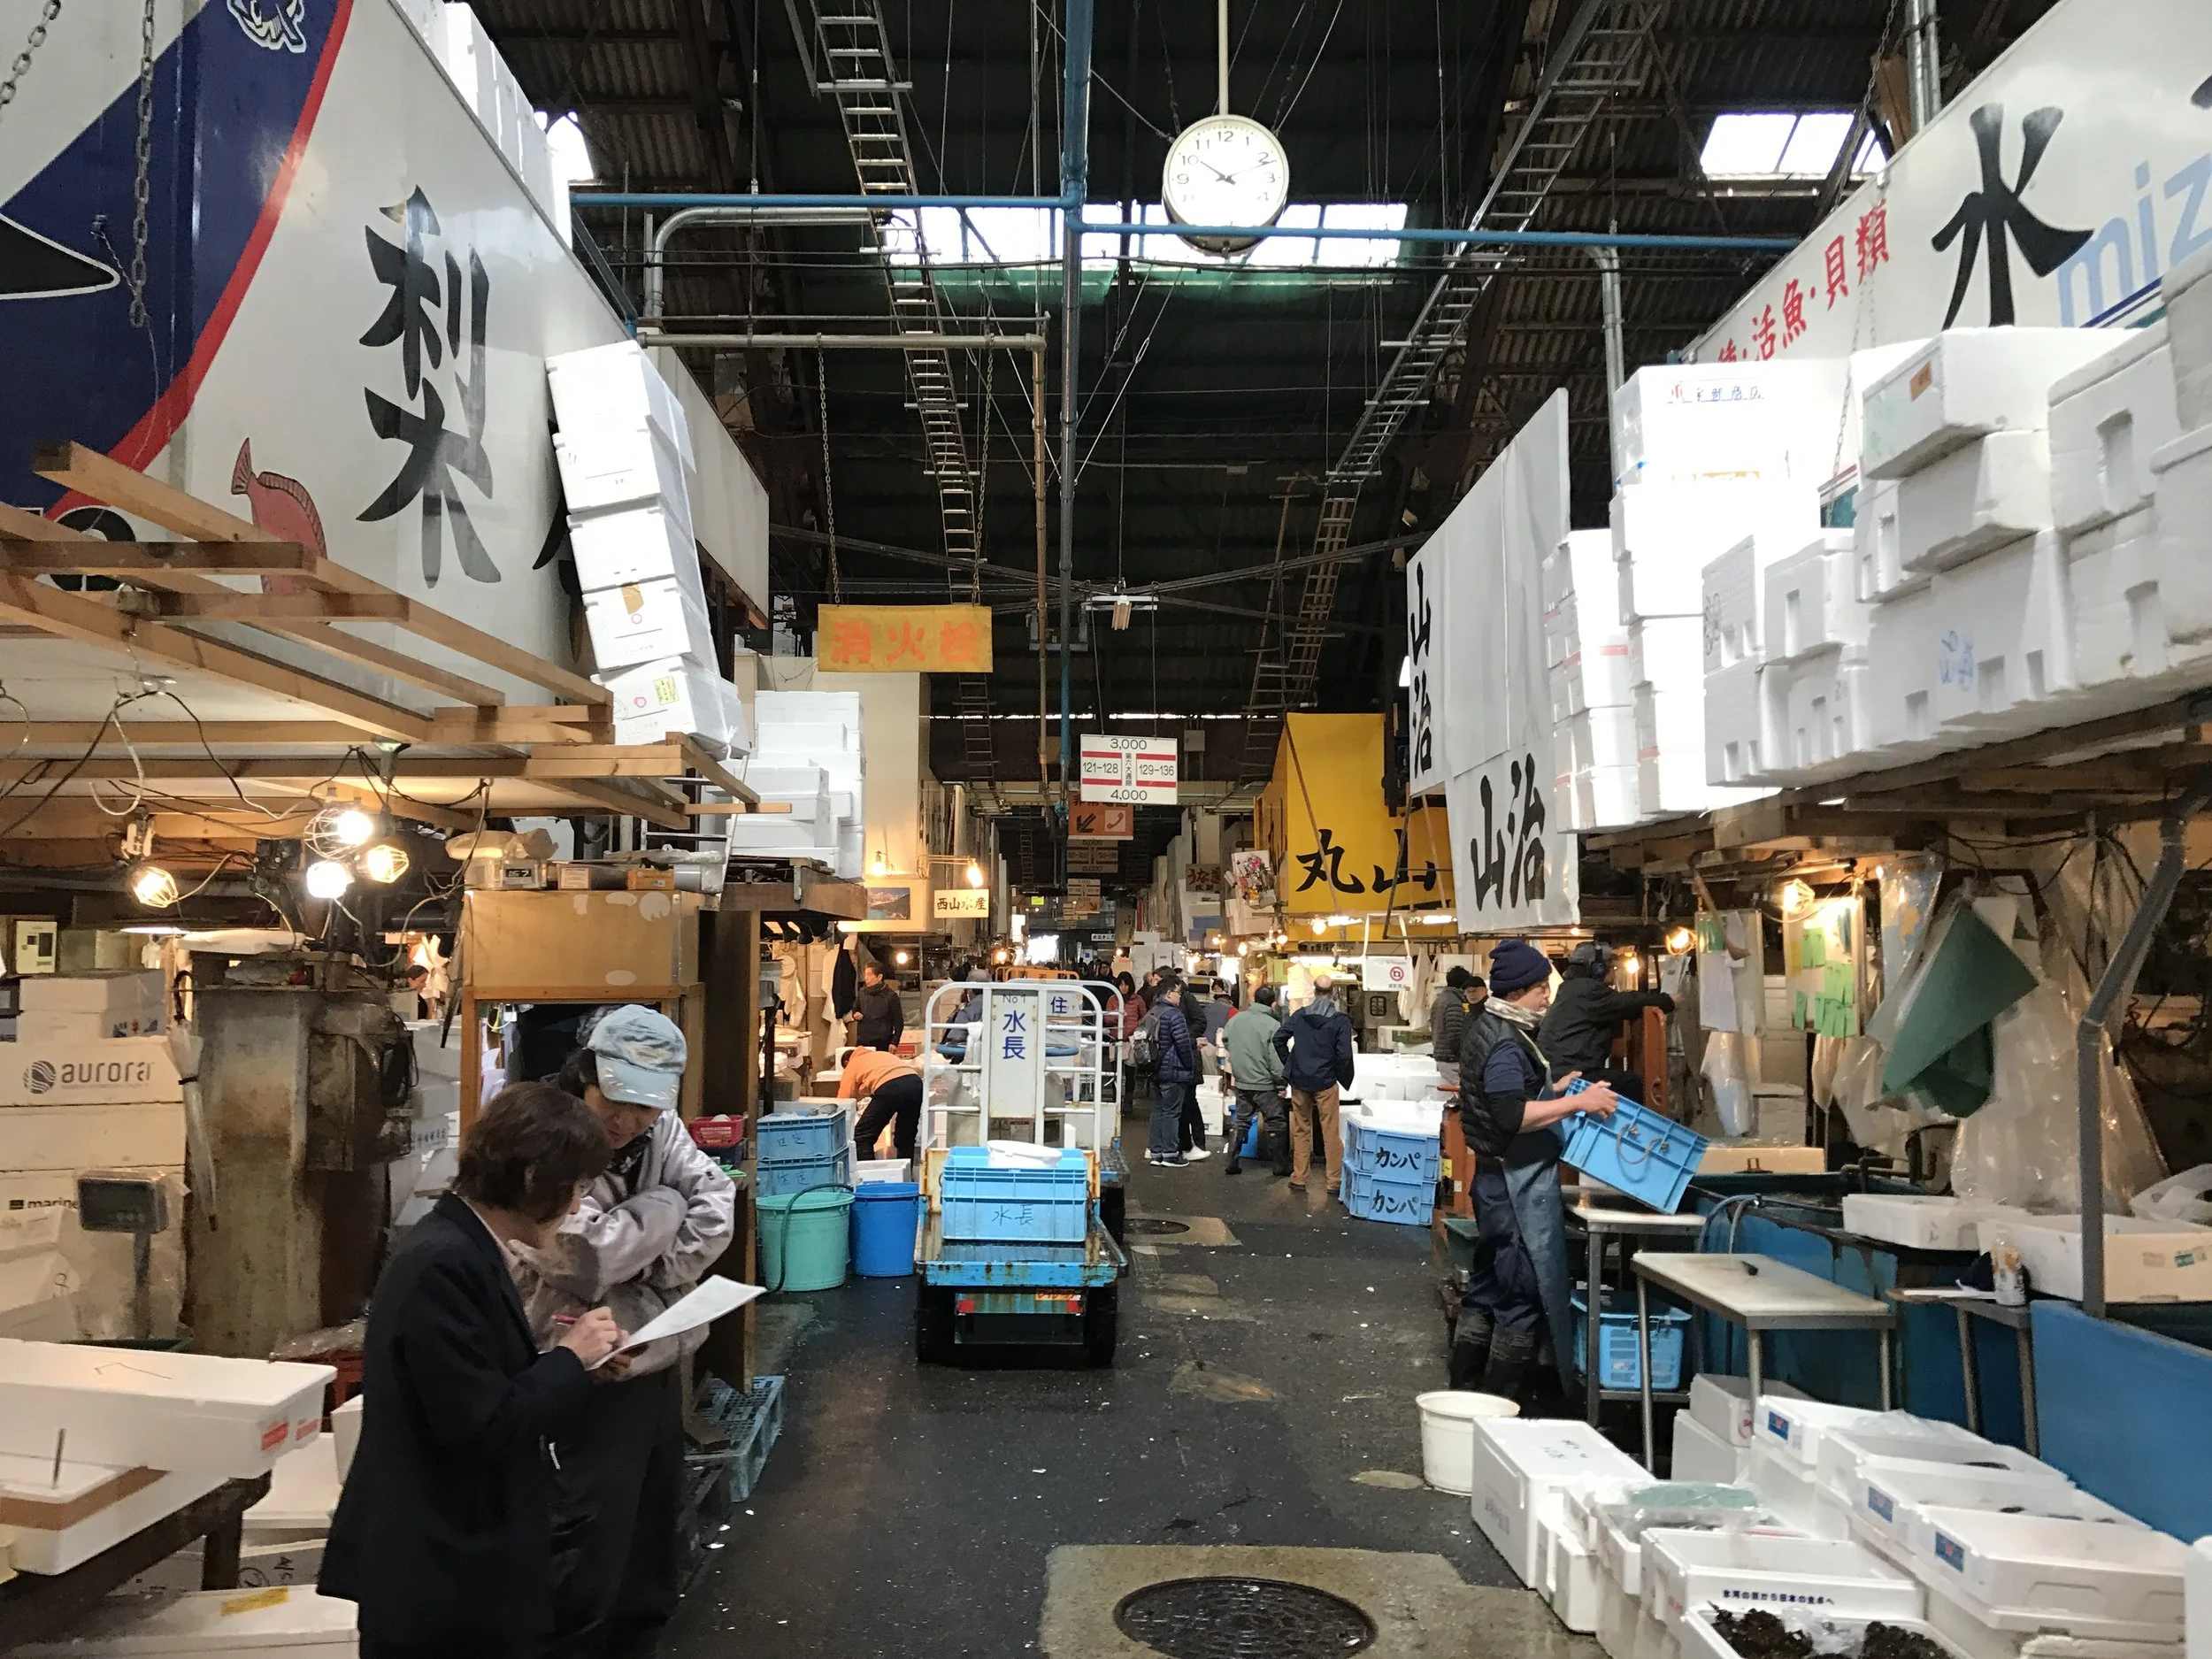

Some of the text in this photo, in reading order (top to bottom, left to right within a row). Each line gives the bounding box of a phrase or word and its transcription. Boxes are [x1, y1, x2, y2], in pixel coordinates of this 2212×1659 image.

[1195, 139, 1210, 150] 11
[1217, 131, 1234, 142] 12
[1182, 155, 1199, 165] 10
[1931, 104, 2094, 330] 水
[2056, 152, 2212, 327] miz
[831, 619, 979, 664] 消火栓
[1410, 562, 1432, 780] 山治
[1110, 738, 1148, 750] 3,000
[1082, 762, 1119, 774] 121-128
[1139, 764, 1175, 776] 129-136
[1110, 789, 1148, 801] 4,000
[1470, 753, 1547, 912] 山治
[1295, 828, 1437, 894] 丸山
[937, 896, 987, 911] 西山水産
[1050, 996, 1068, 1014] 住
[1002, 1010, 1026, 1060] 水長
[61, 1061, 151, 1084] aurora
[991, 1203, 1034, 1227] 水長
